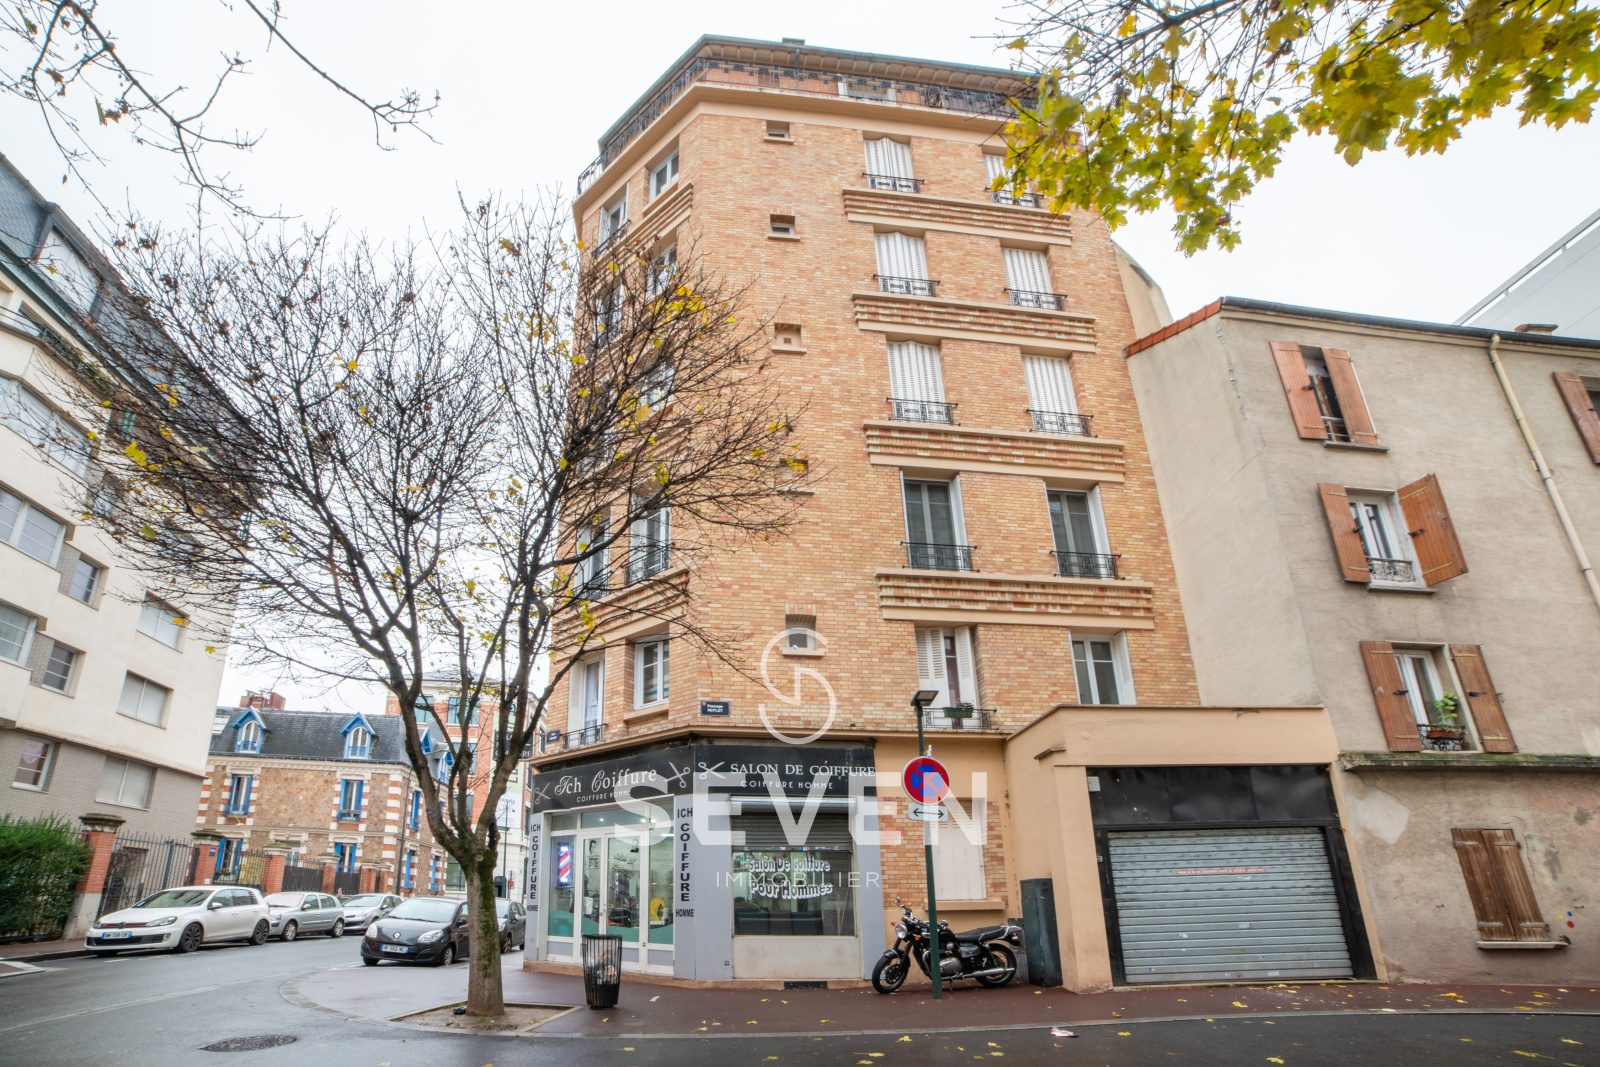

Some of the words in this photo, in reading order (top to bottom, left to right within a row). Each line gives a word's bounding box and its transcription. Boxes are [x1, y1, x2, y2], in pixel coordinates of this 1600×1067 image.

[730, 763, 779, 775] SALON
[785, 764, 804, 775] DE
[809, 765, 876, 777] COIFFURE
[591, 768, 657, 793] Coiffure
[741, 780, 794, 789] COIFFURE
[798, 781, 834, 790] HOMME
[576, 791, 608, 803] COIFFURE
[609, 789, 632, 799] HOMME
[677, 807, 694, 819] ICH
[530, 823, 541, 833] ICH
[530, 835, 539, 900] COIFFURE
[680, 822, 691, 902] COIFFURE
[748, 856, 776, 873] Salon
[776, 857, 791, 872] De
[750, 880, 780, 898] Pour
[780, 879, 834, 900] Hommes
[675, 908, 695, 918] HOMME
